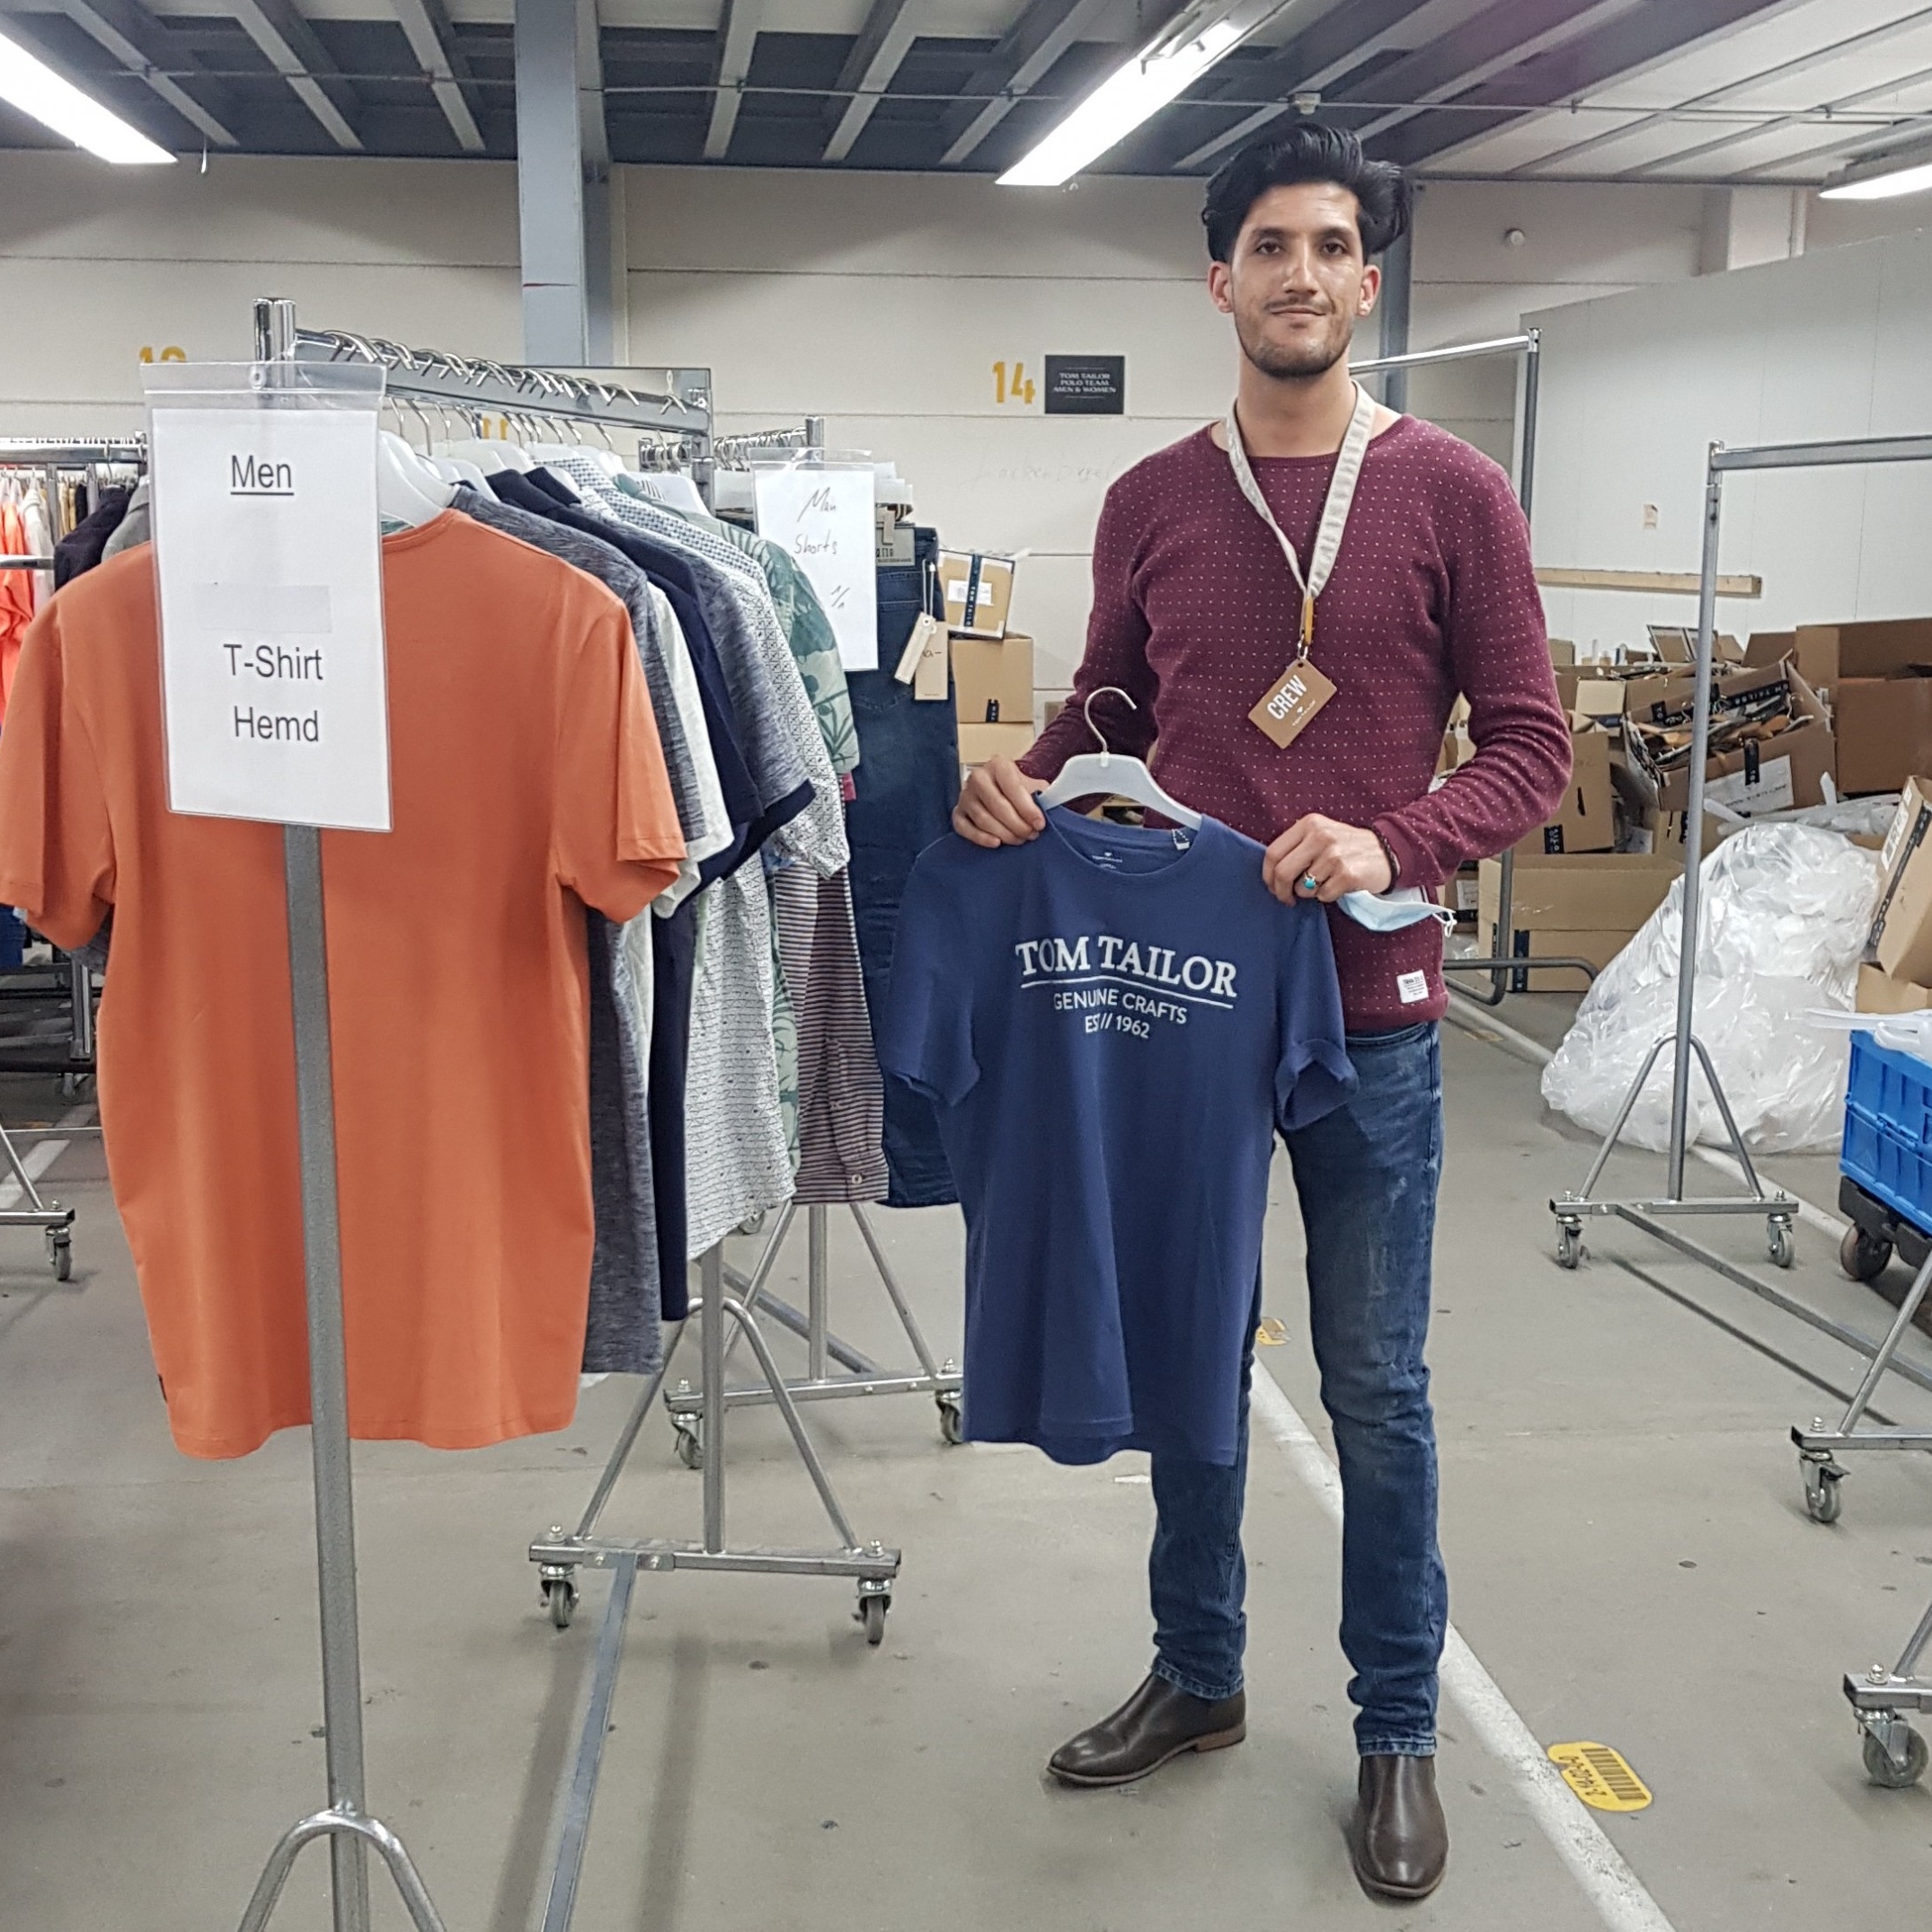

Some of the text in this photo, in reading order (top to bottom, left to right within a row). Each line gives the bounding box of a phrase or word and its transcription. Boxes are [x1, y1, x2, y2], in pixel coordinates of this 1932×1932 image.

[992, 360, 1036, 404] 14
[231, 455, 292, 488] Men
[793, 528, 837, 554] Shorts
[223, 643, 323, 680] T-Shirt
[1267, 674, 1307, 720] CREW
[234, 705, 319, 742] Hemd
[1015, 935, 1237, 998] TOM TAILOR
[1053, 988, 1188, 1024] GENUNE CRAFTS
[1115, 1015, 1150, 1039] 1962
